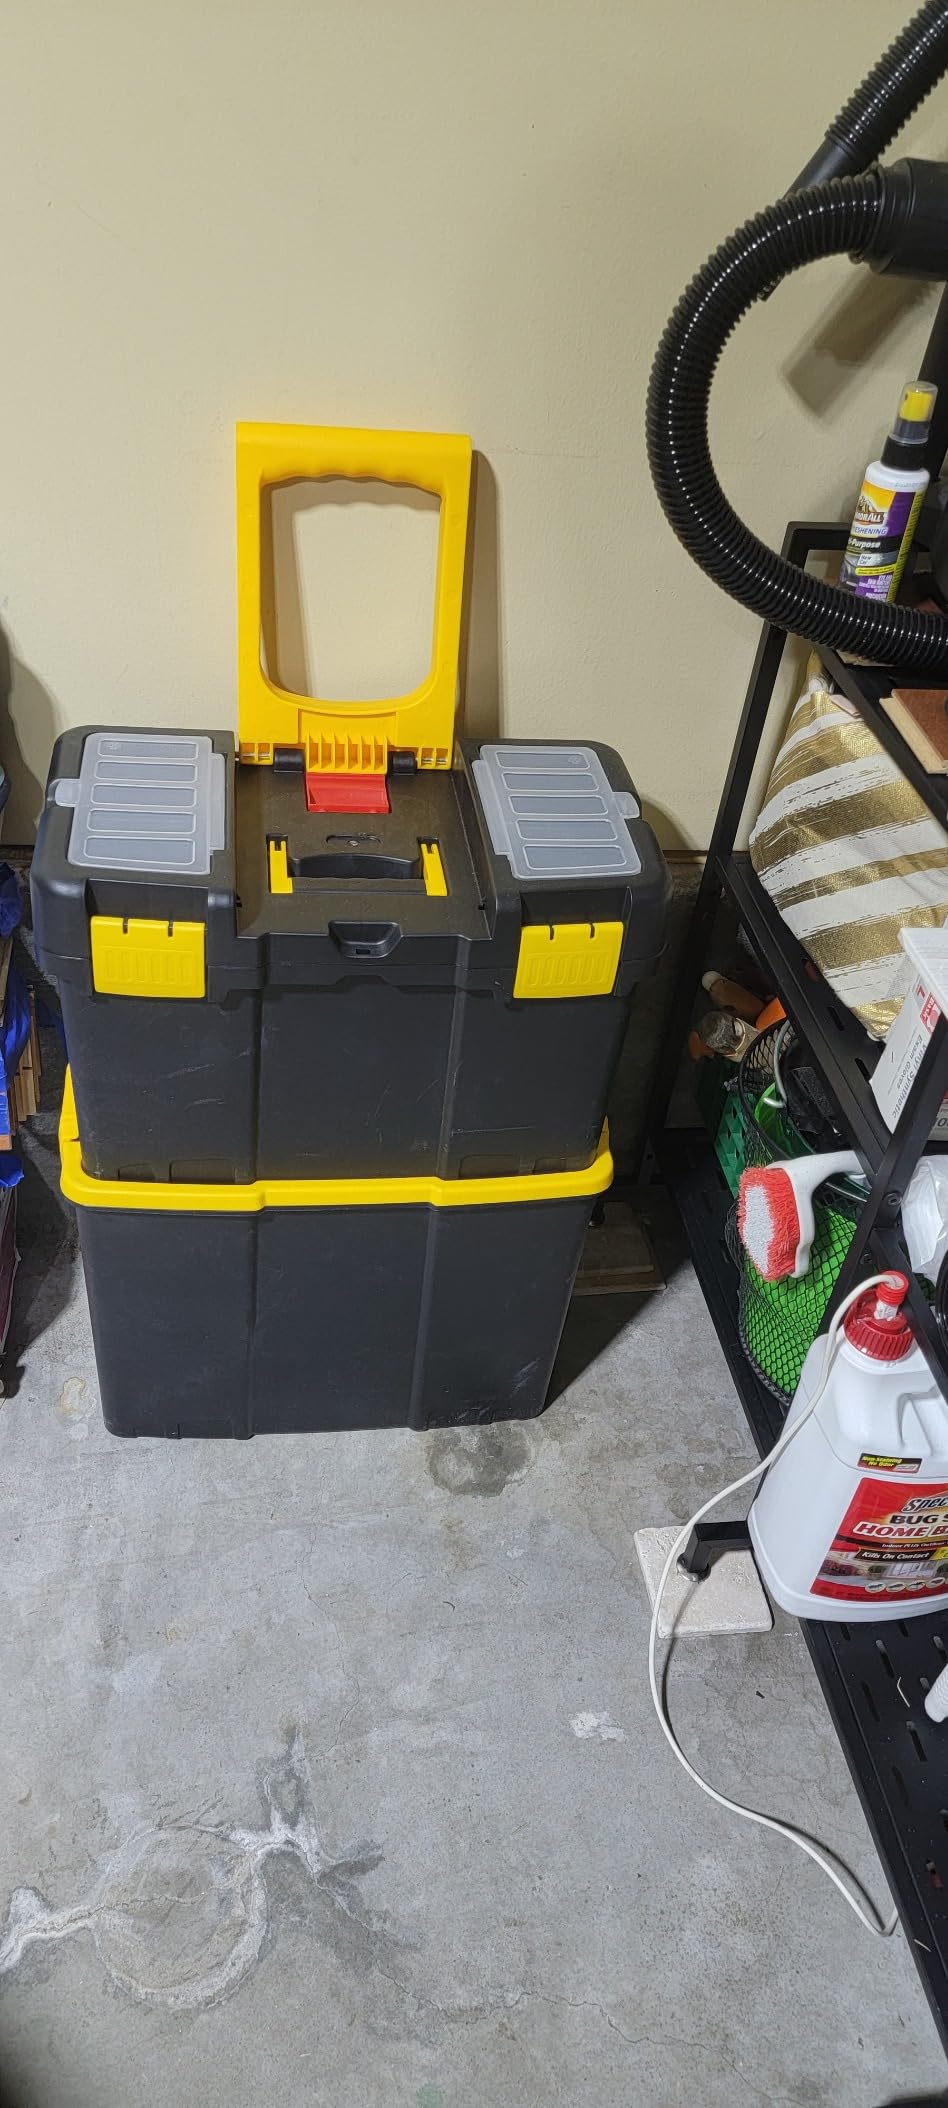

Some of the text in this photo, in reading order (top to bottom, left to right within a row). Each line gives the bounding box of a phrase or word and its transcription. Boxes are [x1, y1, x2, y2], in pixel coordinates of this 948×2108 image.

[897, 1034, 923, 1089] Exam Gloves
[892, 1070, 915, 1118] Synthetic
[890, 1514, 939, 1525] BUG
[855, 1523, 930, 1537] HOME
[862, 1551, 881, 1559] Kills
